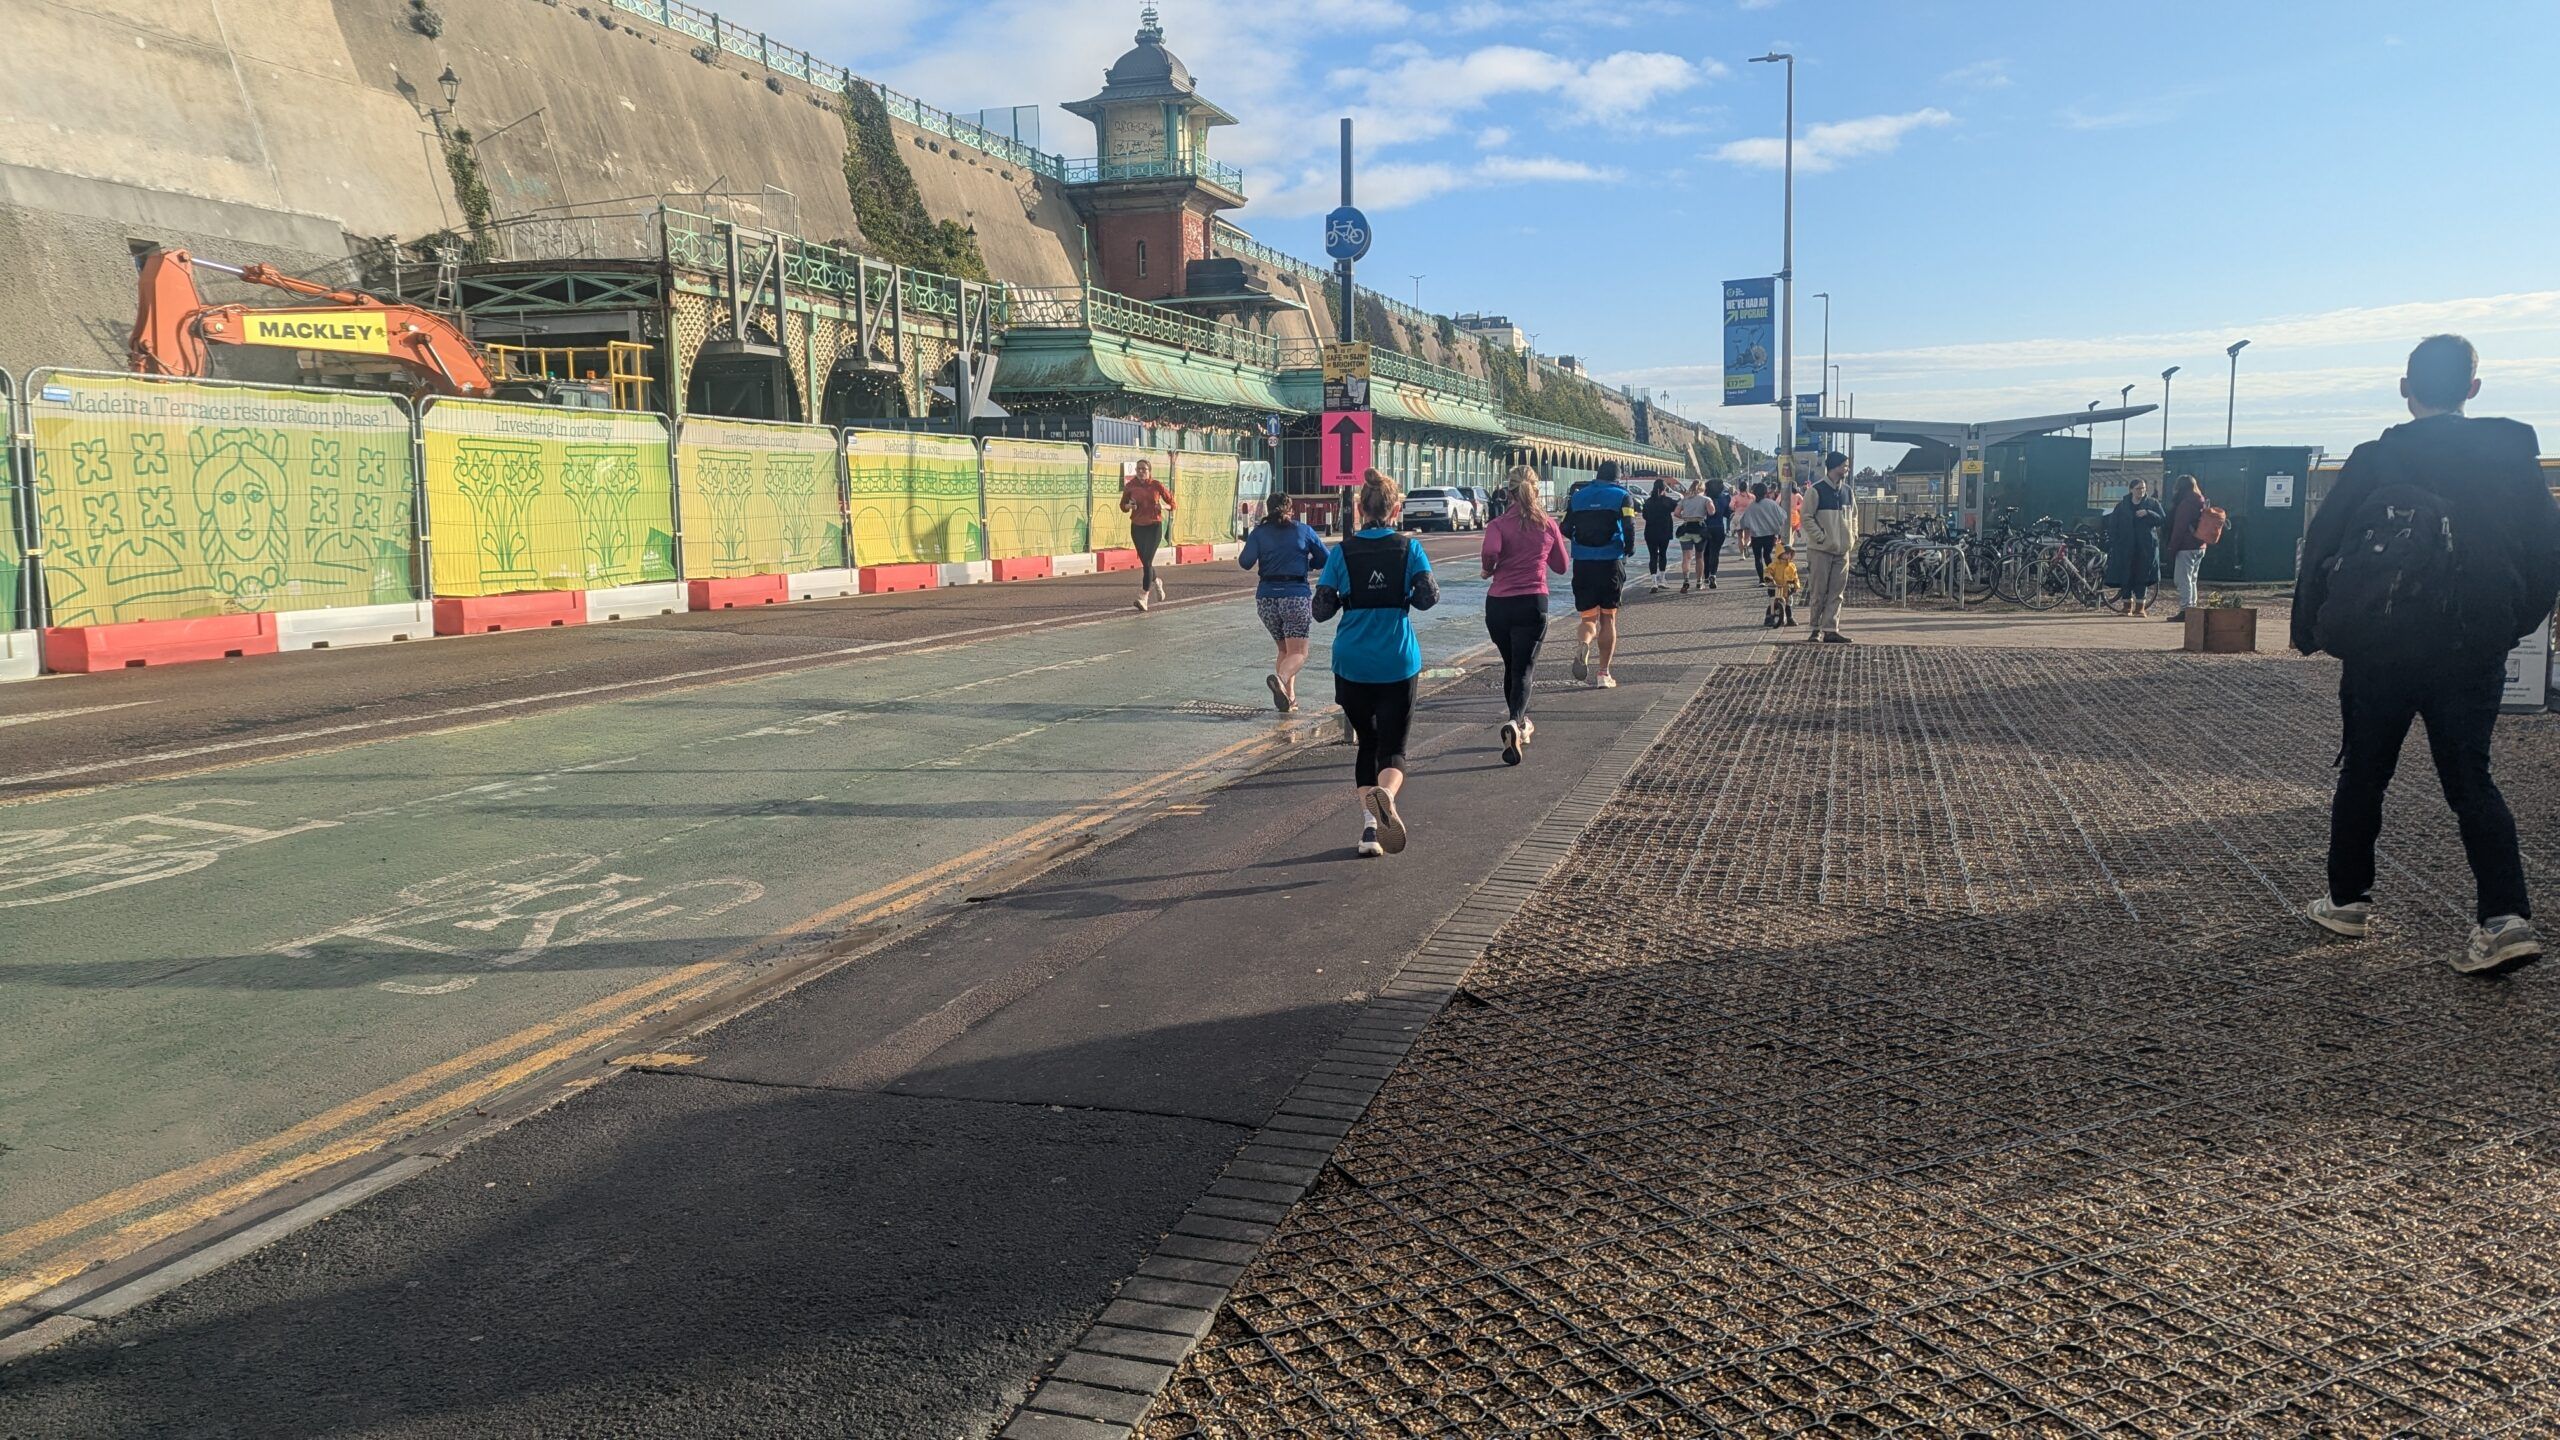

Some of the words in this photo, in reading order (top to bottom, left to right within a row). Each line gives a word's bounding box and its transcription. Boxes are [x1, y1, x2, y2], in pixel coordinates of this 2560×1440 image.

[1726, 298, 1745, 310] WE'VE
[1746, 298, 1758, 308] HAD
[1759, 297, 1768, 307] AN
[1740, 308, 1768, 319] UPGRADE
[259, 321, 372, 340] MACKLEY
[63, 390, 150, 415] Madeira
[153, 396, 231, 421] Terrace
[233, 404, 329, 426] restoration
[332, 405, 379, 428] phase
[382, 410, 392, 426] 1
[494, 415, 553, 438] Investing
[556, 419, 568, 436] in
[569, 426, 591, 438] our
[591, 422, 614, 440] city
[721, 430, 761, 448] Investing
[884, 439, 909, 453] Rebirth
